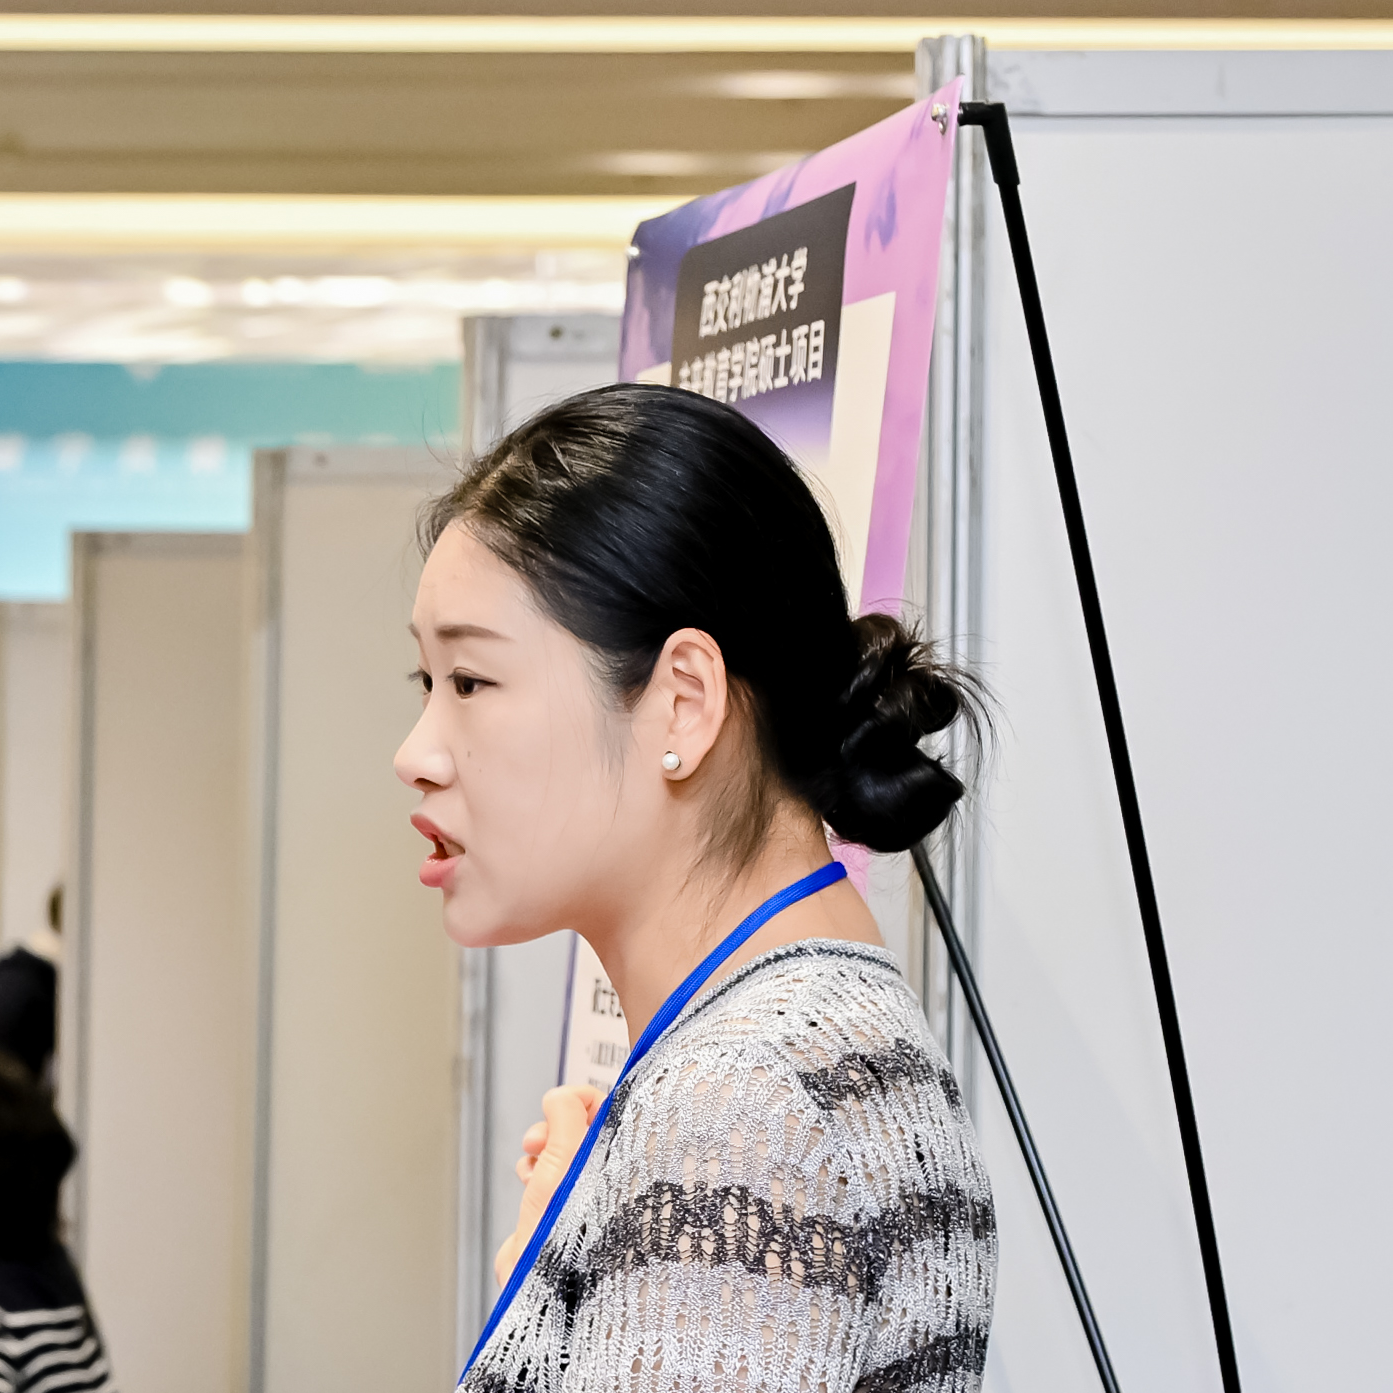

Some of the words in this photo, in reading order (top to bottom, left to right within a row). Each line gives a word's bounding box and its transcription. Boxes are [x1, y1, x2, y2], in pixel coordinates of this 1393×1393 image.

[699, 246, 808, 339] 西交利物浦大学
